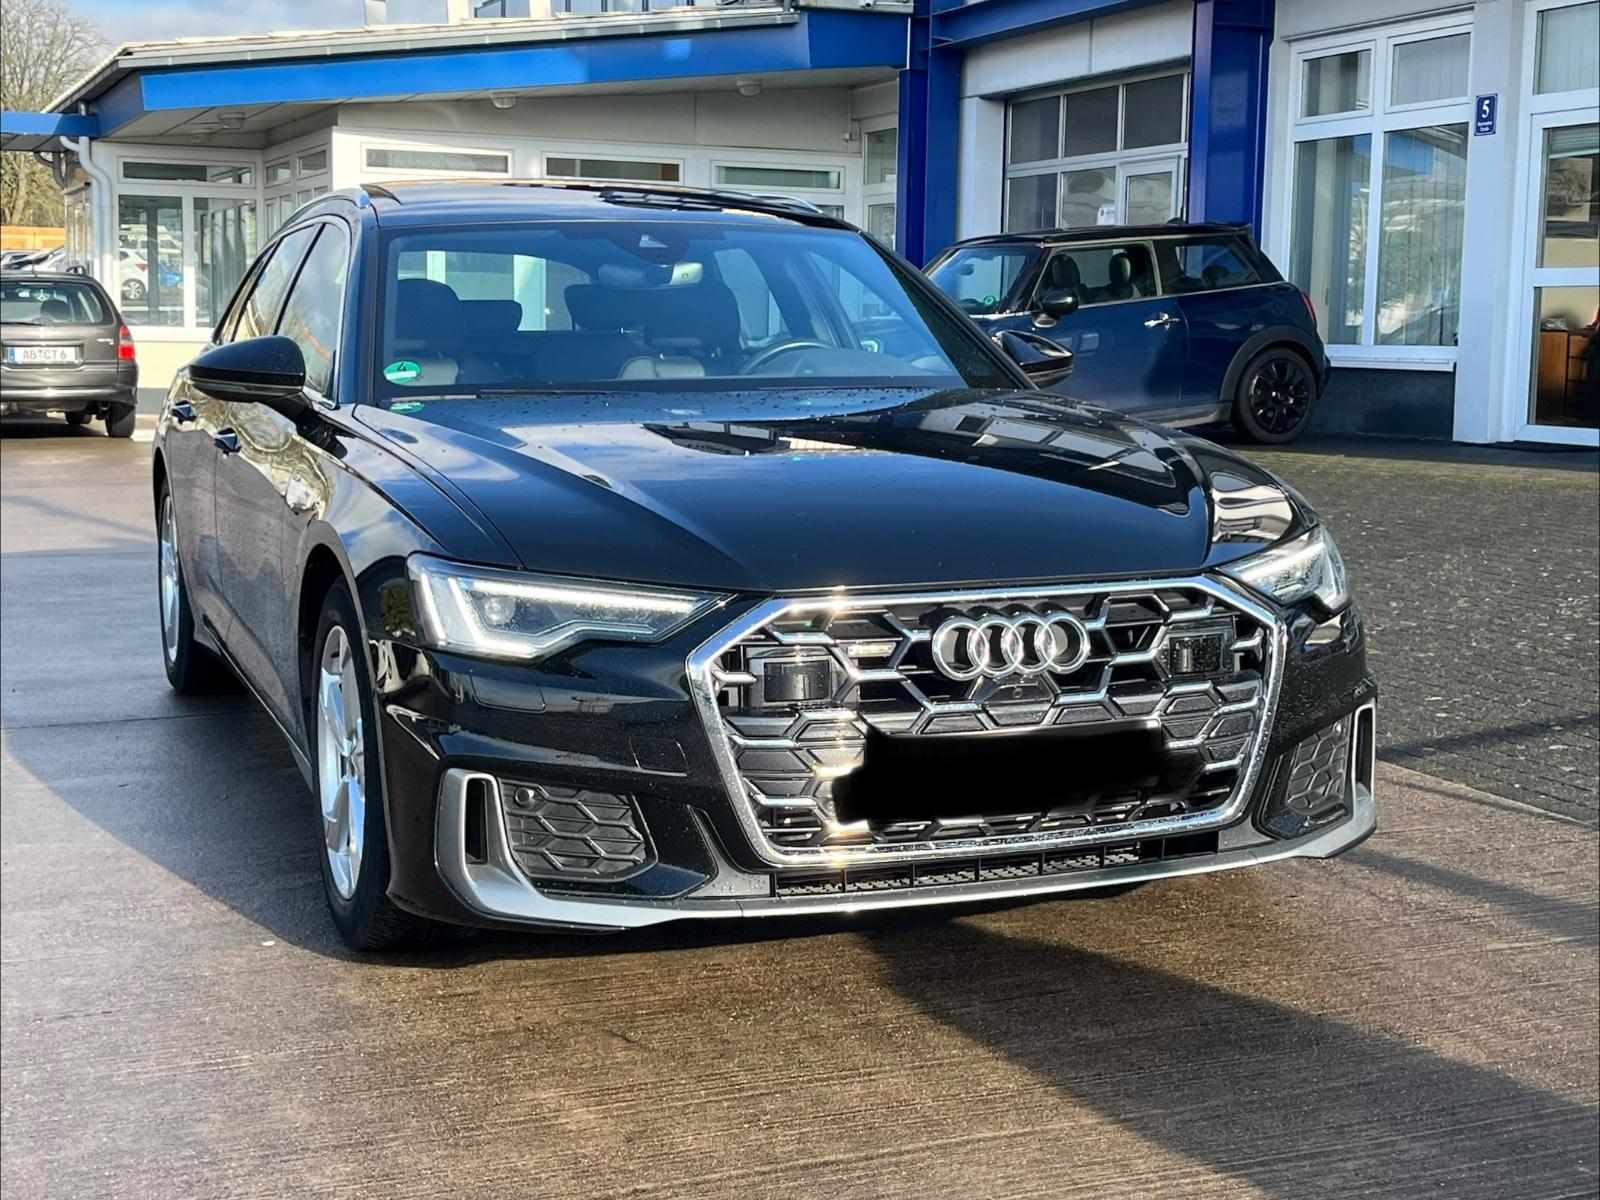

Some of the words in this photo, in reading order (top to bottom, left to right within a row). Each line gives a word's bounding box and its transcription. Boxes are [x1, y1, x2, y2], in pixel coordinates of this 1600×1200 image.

[1482, 100, 1490, 118] 5
[23, 349, 37, 360] AB
[43, 349, 58, 360] CT
[60, 349, 67, 360] 6
[397, 362, 406, 371] 4
